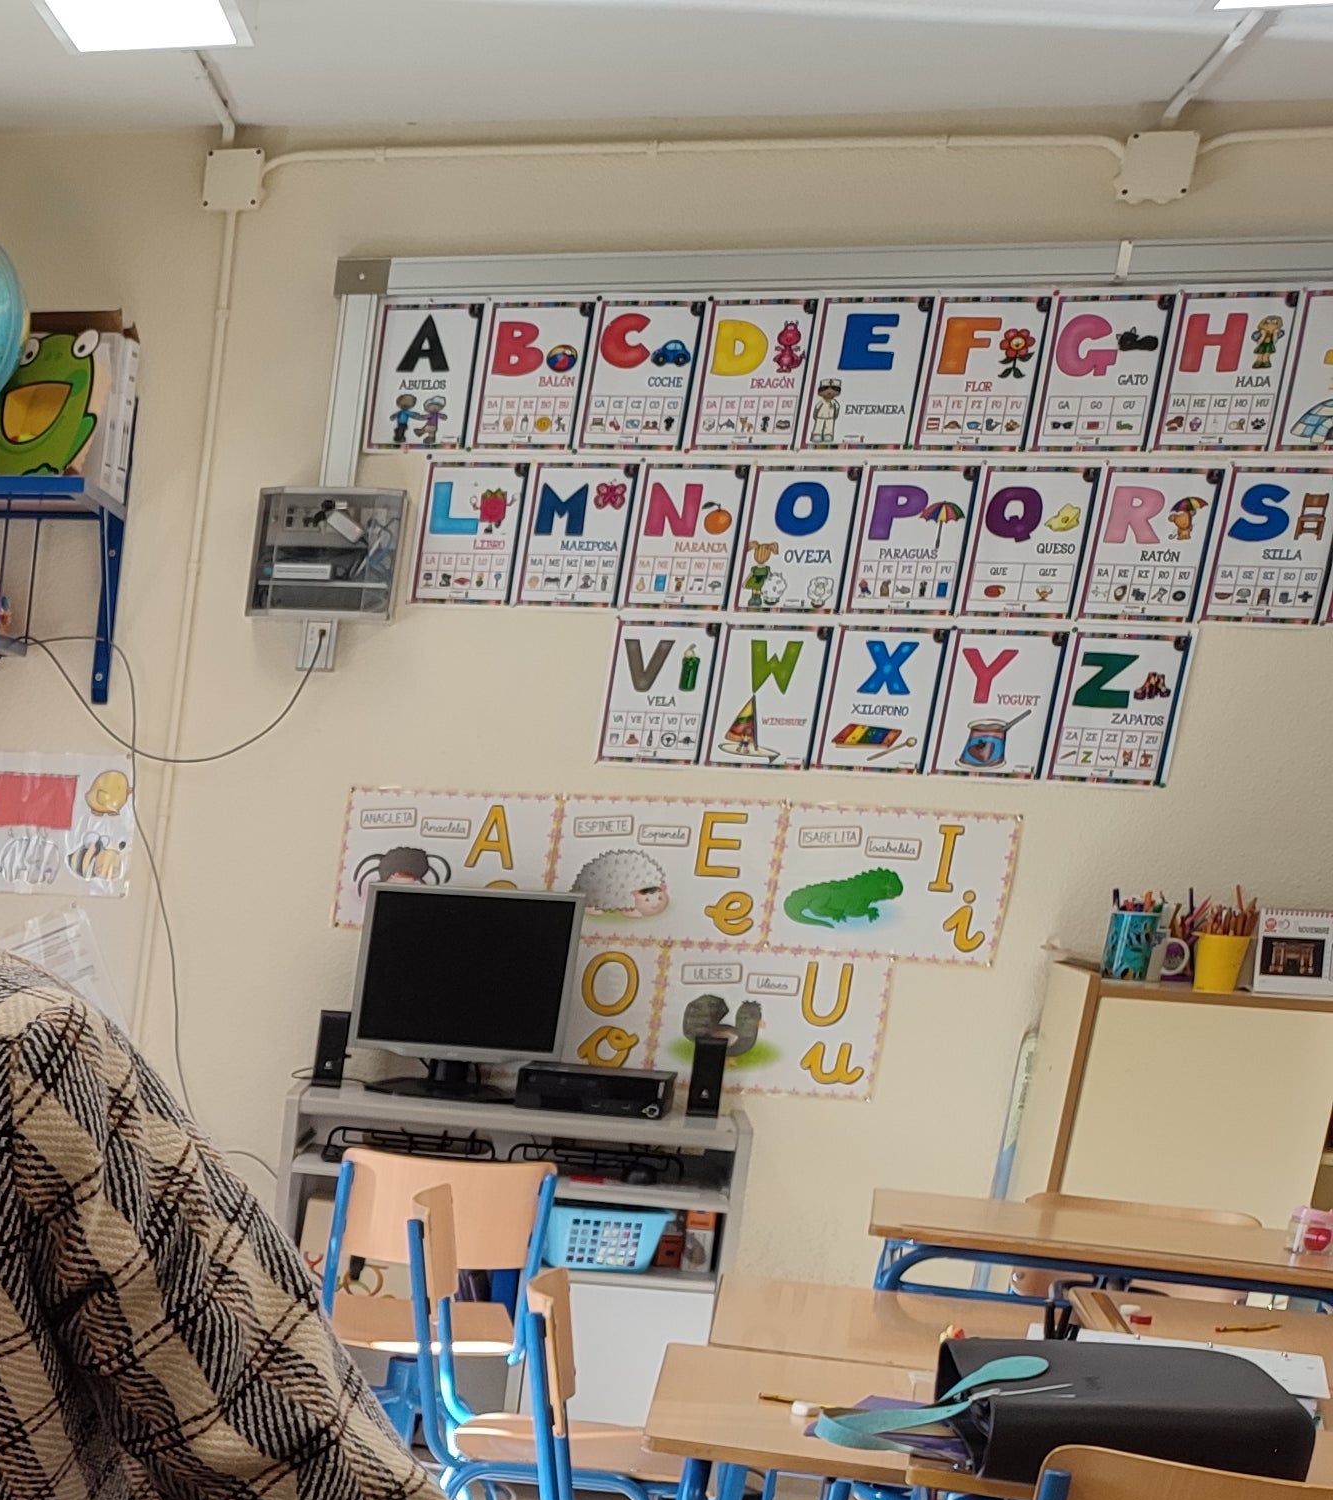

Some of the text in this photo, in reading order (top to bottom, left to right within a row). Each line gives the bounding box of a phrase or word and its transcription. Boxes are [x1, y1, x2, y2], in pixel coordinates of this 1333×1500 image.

[396, 314, 450, 372] A
[600, 312, 651, 369] C
[710, 319, 769, 376] D
[837, 313, 900, 371] E
[936, 317, 1002, 375] F
[1055, 313, 1118, 377] G
[1179, 312, 1249, 373] H
[491, 320, 544, 377] B
[399, 379, 447, 391] ABUELOS
[538, 375, 575, 388] BALÓN
[647, 376, 683, 389] COCHE
[749, 375, 795, 389] DRAGÓN
[964, 380, 993, 393] FLOR
[1117, 374, 1149, 386] GATO
[1235, 376, 1271, 388] HADA
[844, 404, 906, 416] ENFERMERA
[1057, 401, 1136, 410] GA GO GU
[429, 481, 478, 535] L
[534, 482, 589, 536] M
[643, 482, 704, 537] N
[774, 481, 831, 537] O
[868, 484, 929, 541] P
[985, 486, 1043, 543] Q
[1103, 485, 1166, 544] R
[1227, 483, 1291, 542] S
[473, 539, 506, 550] LIBRO
[560, 540, 618, 552] MARIPOSA
[674, 541, 728, 553] NARANJA
[1036, 543, 1076, 555] QUESO
[784, 549, 833, 564] OVEJA
[879, 548, 938, 560] PARAGUAS
[1140, 548, 1181, 562] RATÓN
[1261, 548, 1302, 561] SILLA
[989, 566, 1058, 577] QUE QUI
[1096, 568, 1191, 580] RA RE RI RO RU
[1220, 570, 1318, 582] SA SE SI SO SU
[624, 638, 676, 692] V
[751, 639, 804, 695] W
[856, 640, 920, 695] X
[962, 647, 1019, 704] Y
[1071, 652, 1140, 709] Z
[647, 695, 676, 707] VELA
[996, 694, 1041, 707] YOGURT
[1110, 713, 1164, 727] ZAPATOS
[363, 812, 412, 824] ANACLETA
[422, 820, 466, 834] Anacleta
[577, 819, 628, 834] ESPINETE
[641, 826, 686, 842] Espinete
[464, 804, 514, 870] A
[802, 830, 857, 844] ISABELITA
[694, 811, 748, 879] E
[868, 841, 916, 855] Isabelita
[928, 824, 965, 893] I
[704, 891, 754, 936] e
[942, 889, 986, 953] i
[693, 967, 733, 980] ULISES
[582, 951, 639, 1016] O
[756, 976, 789, 990] Ulises
[801, 961, 854, 1027] U
[800, 1041, 864, 1085] u
